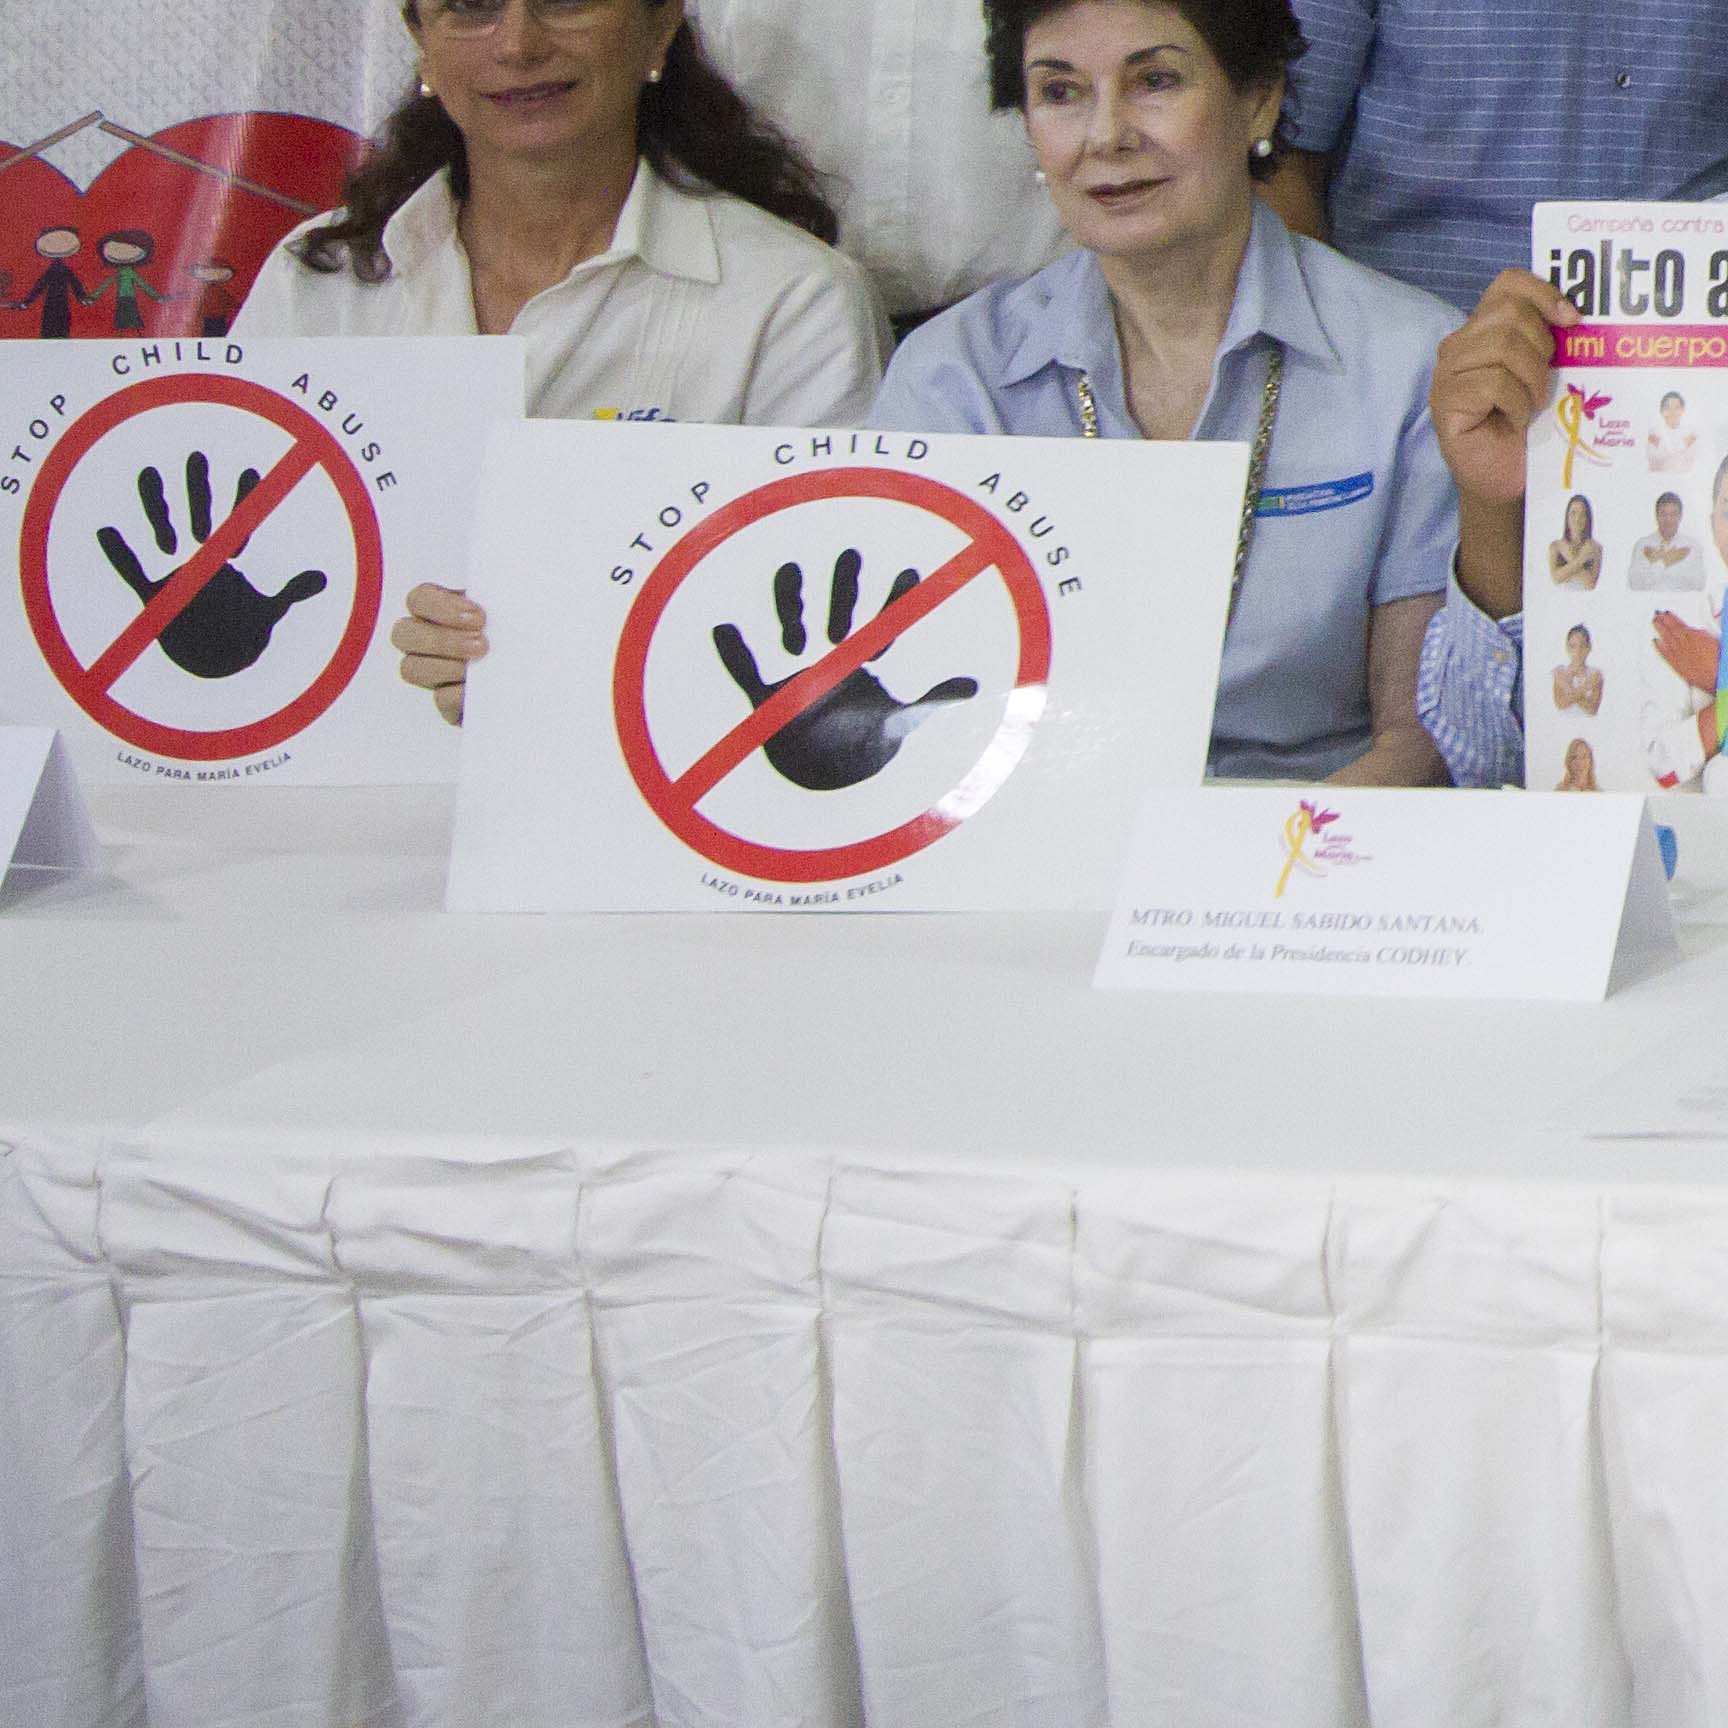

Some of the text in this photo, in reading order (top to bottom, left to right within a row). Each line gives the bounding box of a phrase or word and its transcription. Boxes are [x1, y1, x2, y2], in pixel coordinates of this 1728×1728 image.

[1567, 214, 1654, 235] Campaña
[1662, 217, 1725, 234] contra
[1615, 334, 1727, 365] cuerpo
[0, 341, 398, 495] STOP CHILD ABUSE
[610, 432, 1084, 598] STOP CHILD ABUSE
[155, 766, 191, 780] PARA
[1204, 910, 1284, 928] MIGUEL
[1291, 912, 1372, 931] SABIDO
[1223, 943, 1246, 960] de
[1249, 943, 1265, 960] la
[1270, 944, 1371, 963] Presidencia
